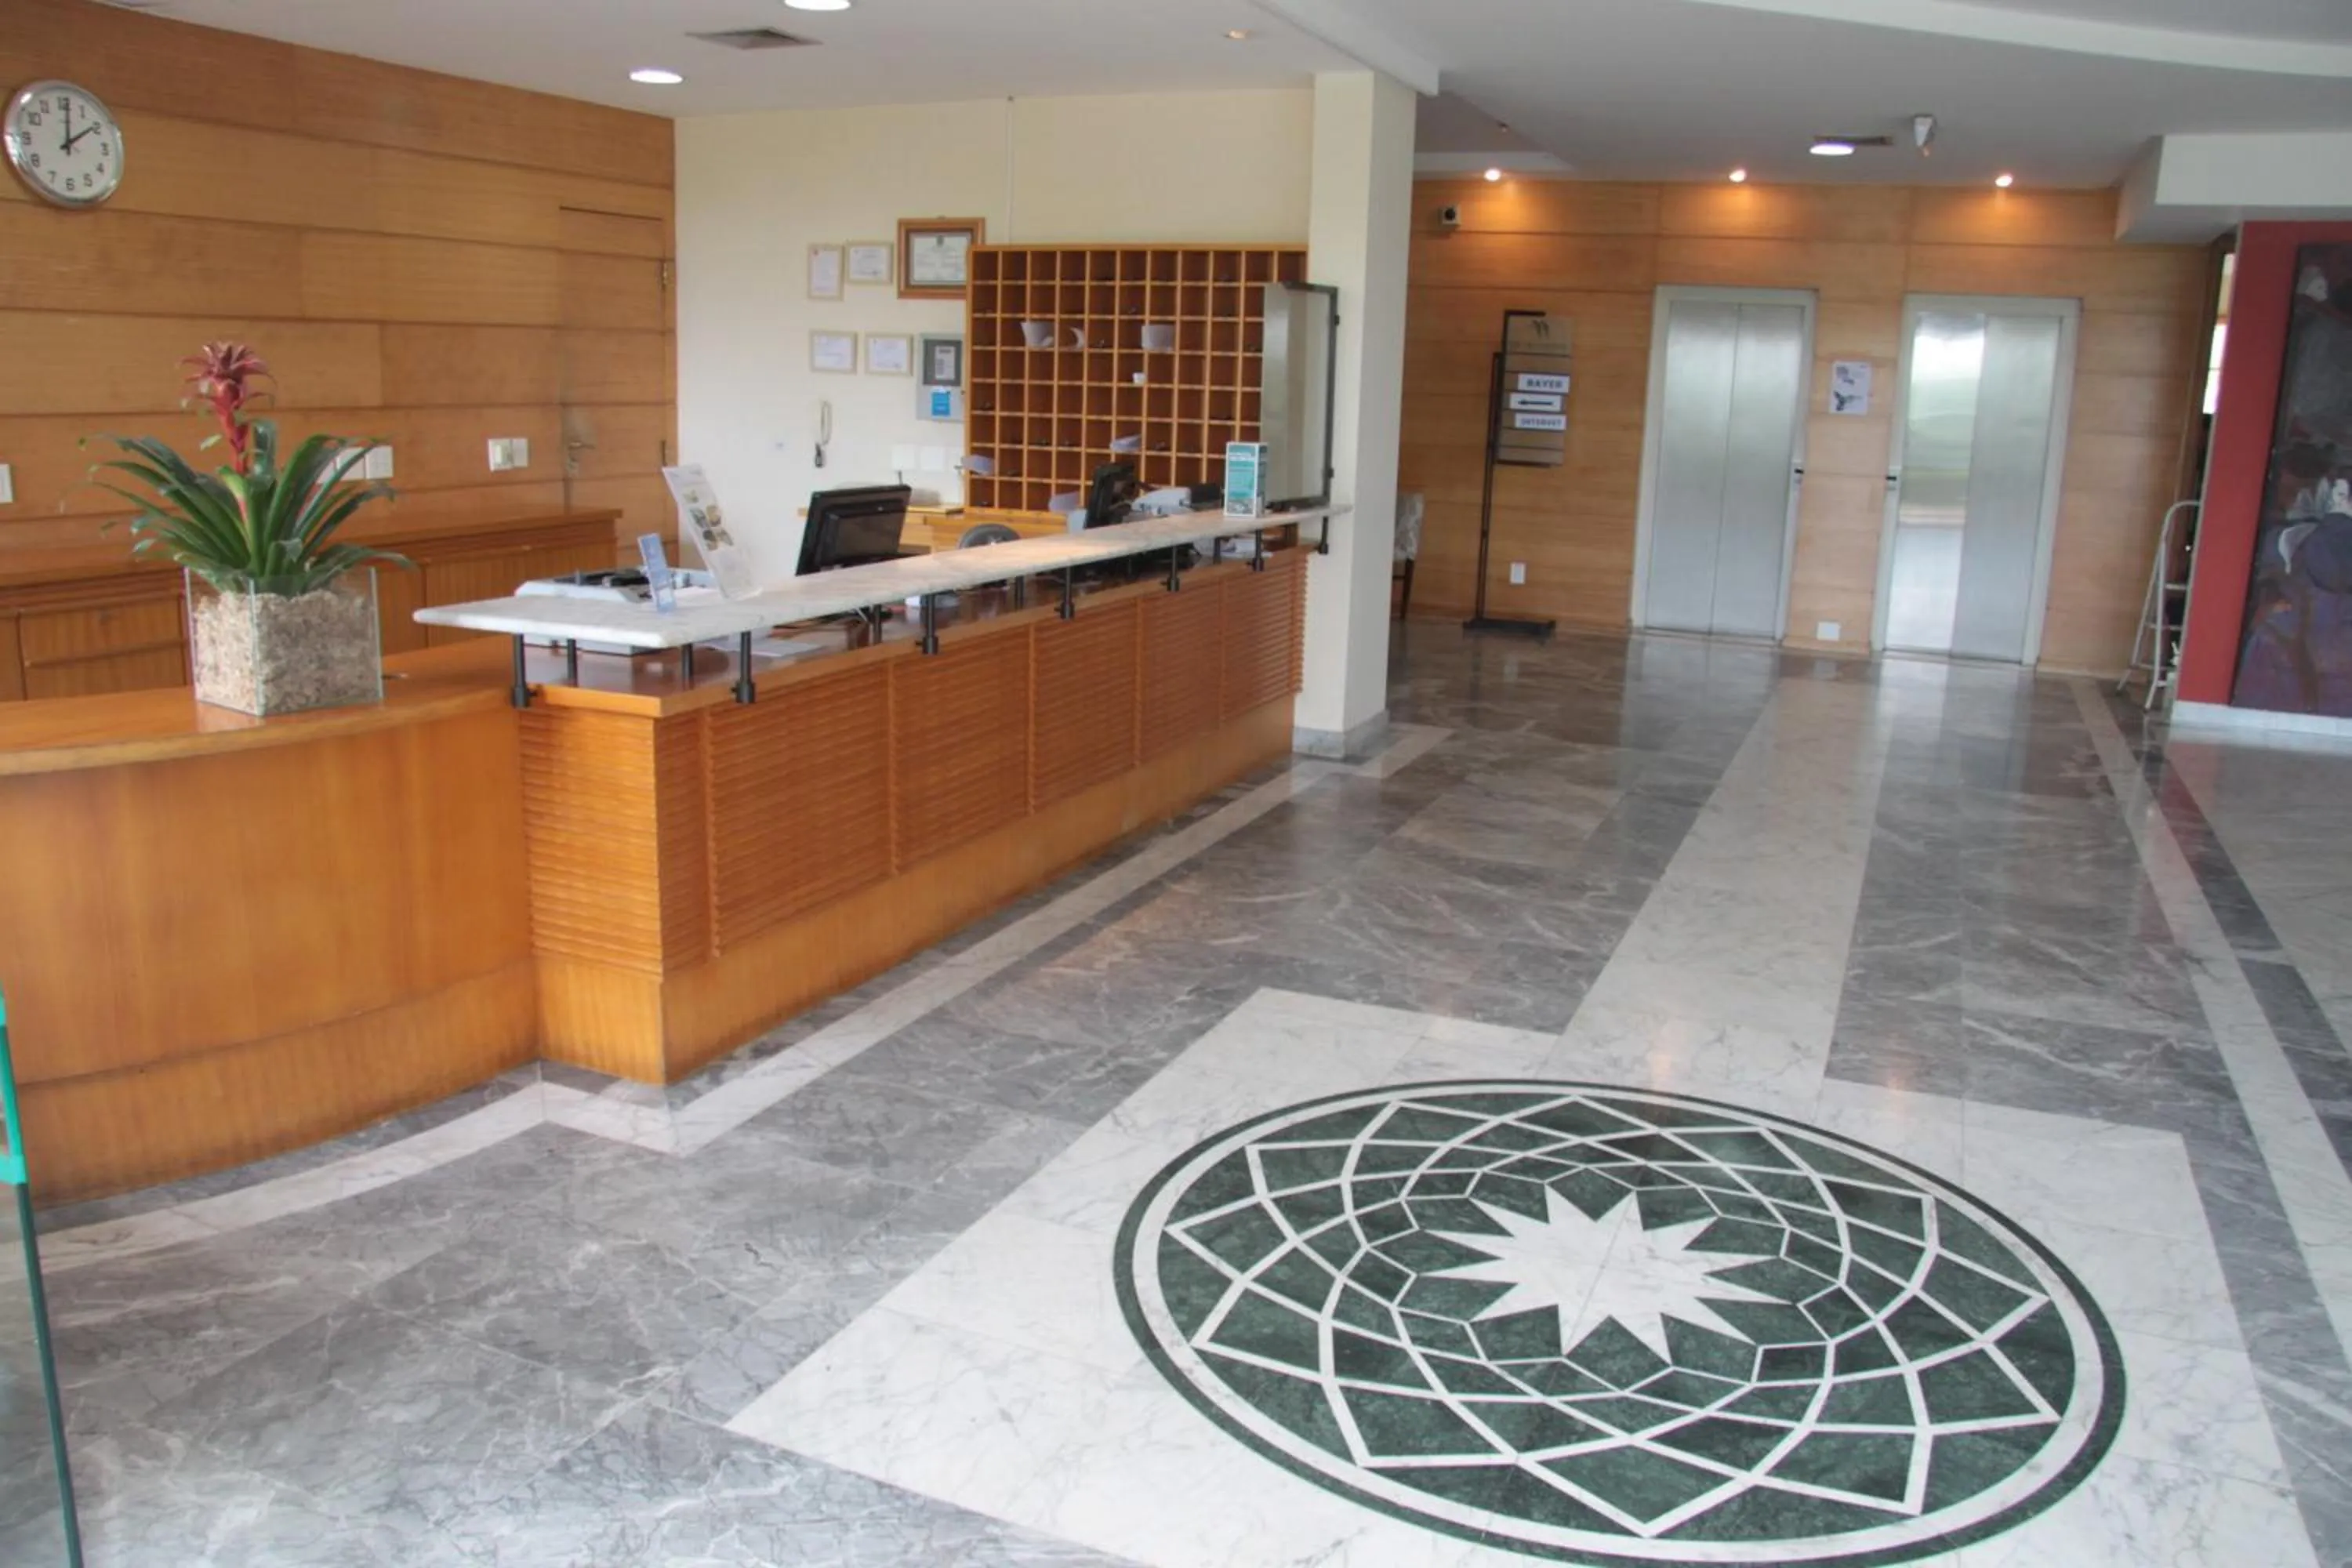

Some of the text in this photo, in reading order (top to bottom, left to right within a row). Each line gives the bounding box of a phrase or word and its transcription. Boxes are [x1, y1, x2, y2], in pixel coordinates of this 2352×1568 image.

[100, 142, 110, 156] 3
[96, 162, 104, 174] 4
[48, 170, 57, 184] 7
[83, 173, 93, 187] 5
[66, 178, 74, 191] 6
